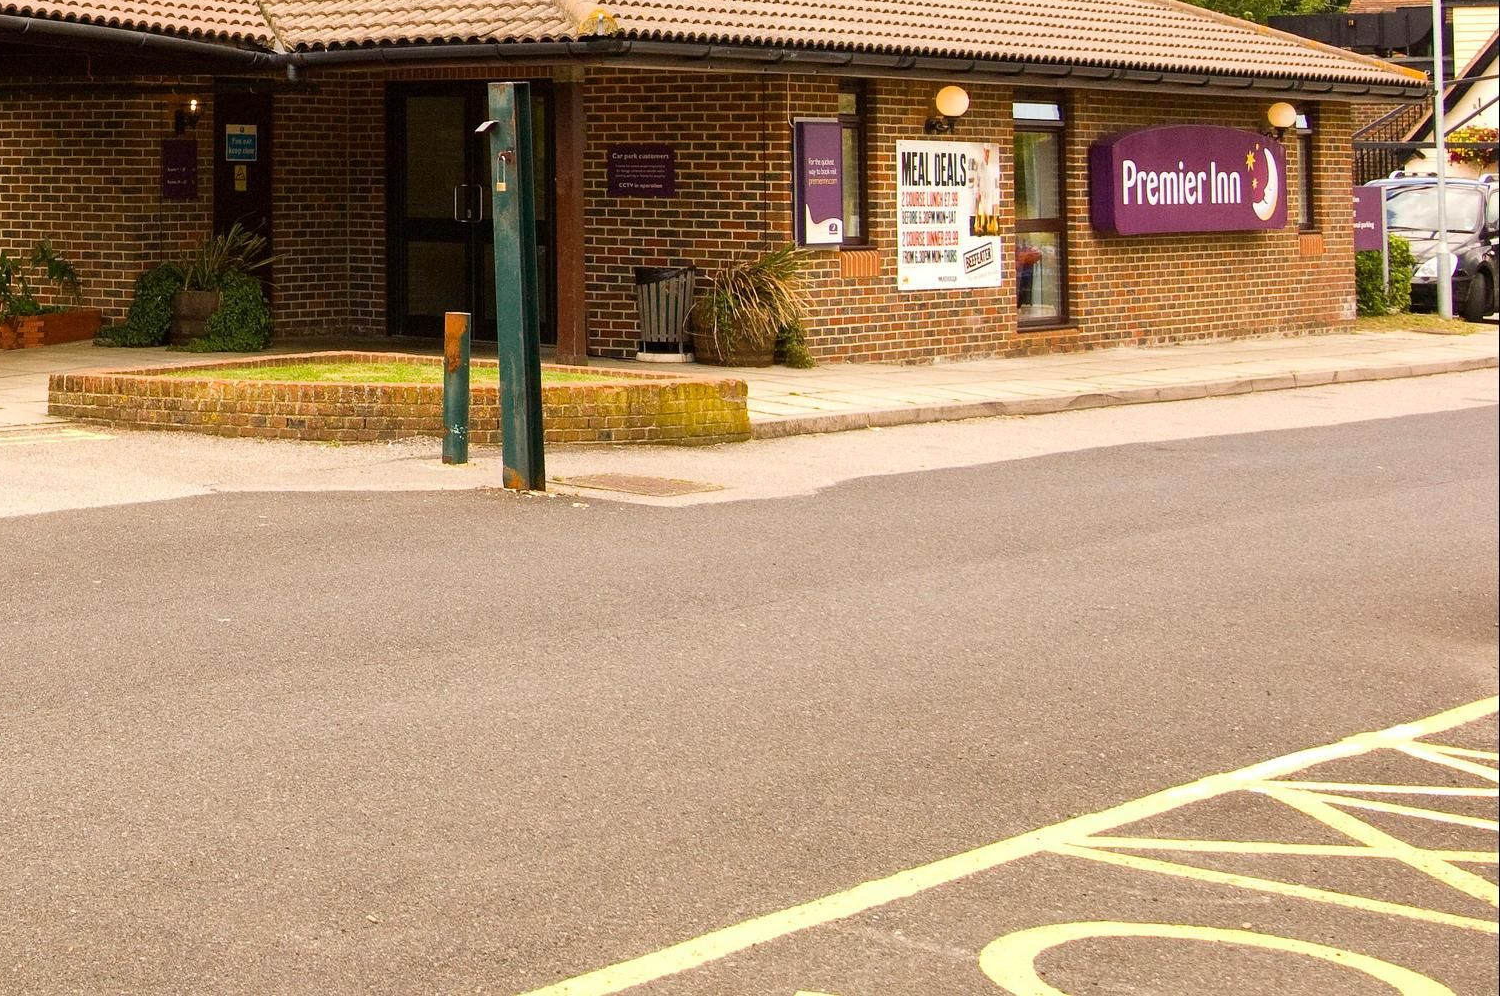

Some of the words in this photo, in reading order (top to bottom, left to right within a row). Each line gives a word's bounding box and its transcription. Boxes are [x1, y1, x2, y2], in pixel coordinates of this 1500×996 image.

[902, 152, 931, 186] MEAL
[934, 153, 966, 186] DEALS
[1123, 160, 1207, 205] Premier
[1211, 161, 1241, 204] Inn
[902, 192, 906, 207] 2
[906, 192, 926, 207] COURSE
[927, 192, 943, 207] LUNCH
[902, 211, 918, 224] BEFORE
[902, 231, 906, 247] 2
[906, 231, 926, 247] COURSE
[927, 231, 944, 246] DINNER
[903, 250, 914, 264] FROM
[965, 248, 992, 269] BEEFEATER
